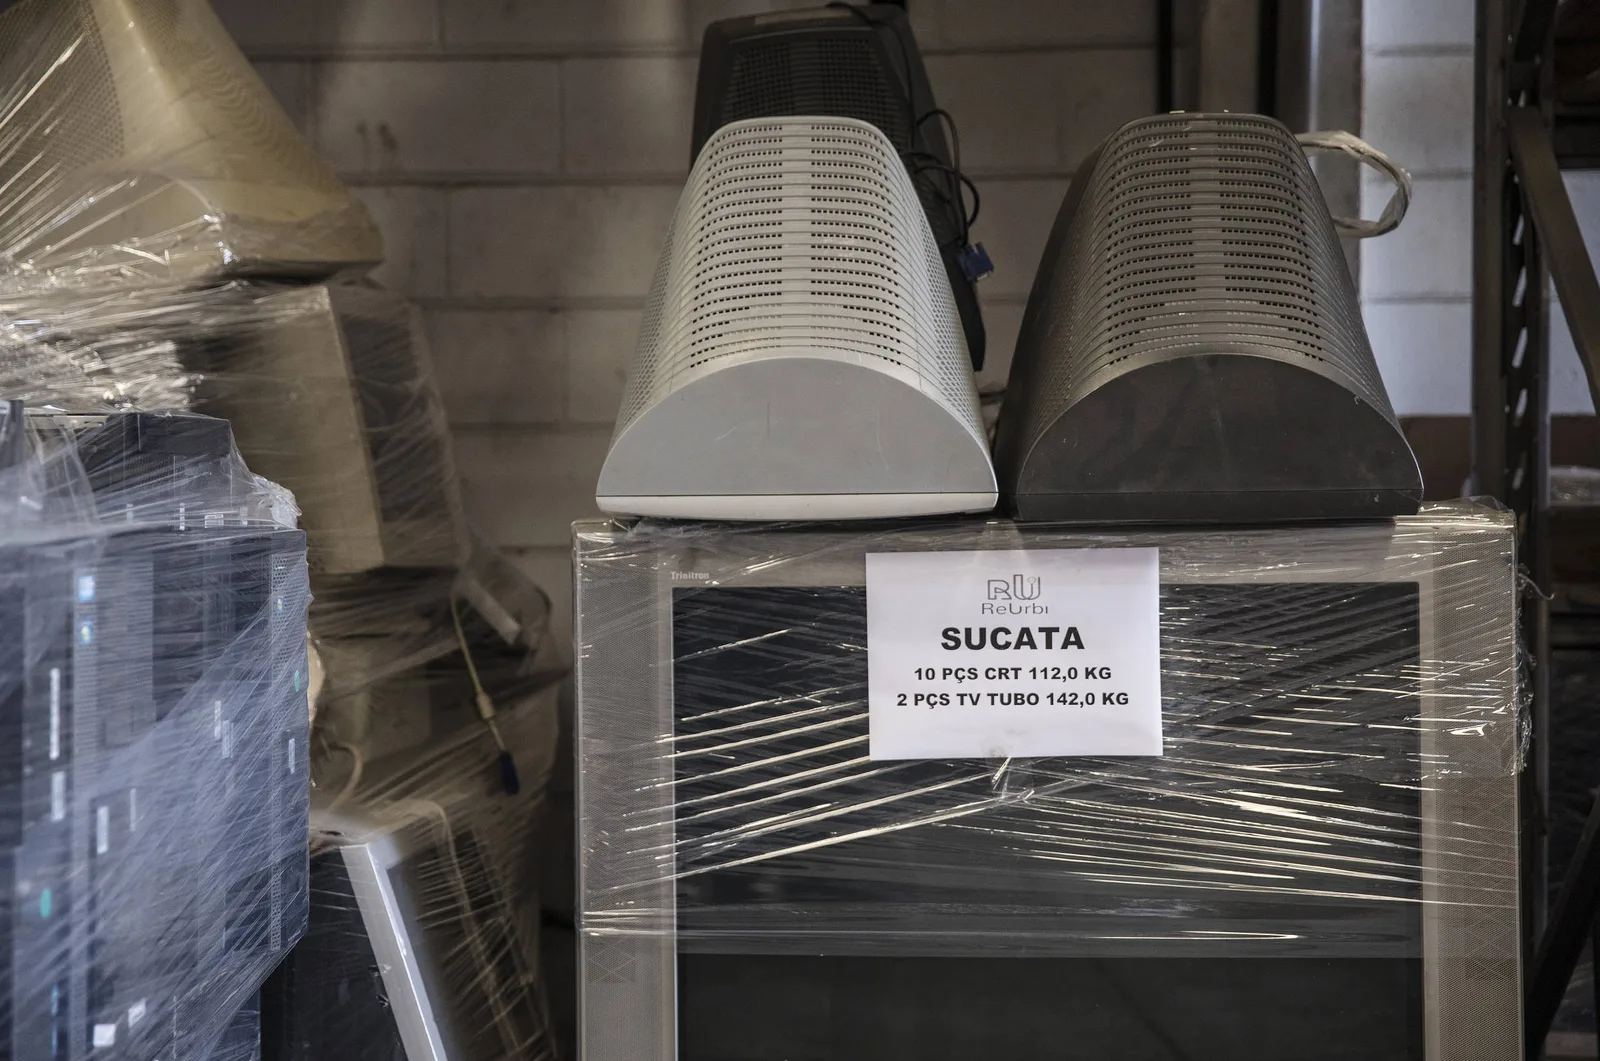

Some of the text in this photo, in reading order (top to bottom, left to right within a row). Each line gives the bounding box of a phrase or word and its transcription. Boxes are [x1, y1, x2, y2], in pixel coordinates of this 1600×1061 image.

[670, 571, 710, 580] Trinitron
[981, 602, 1049, 615] ReUrbi
[940, 626, 1086, 651] SUCATA
[914, 666, 1112, 683] 10 PÇS CRT 112,0 KG
[896, 692, 1129, 709] 2 PÇS TV TUBO 142,0 KG
